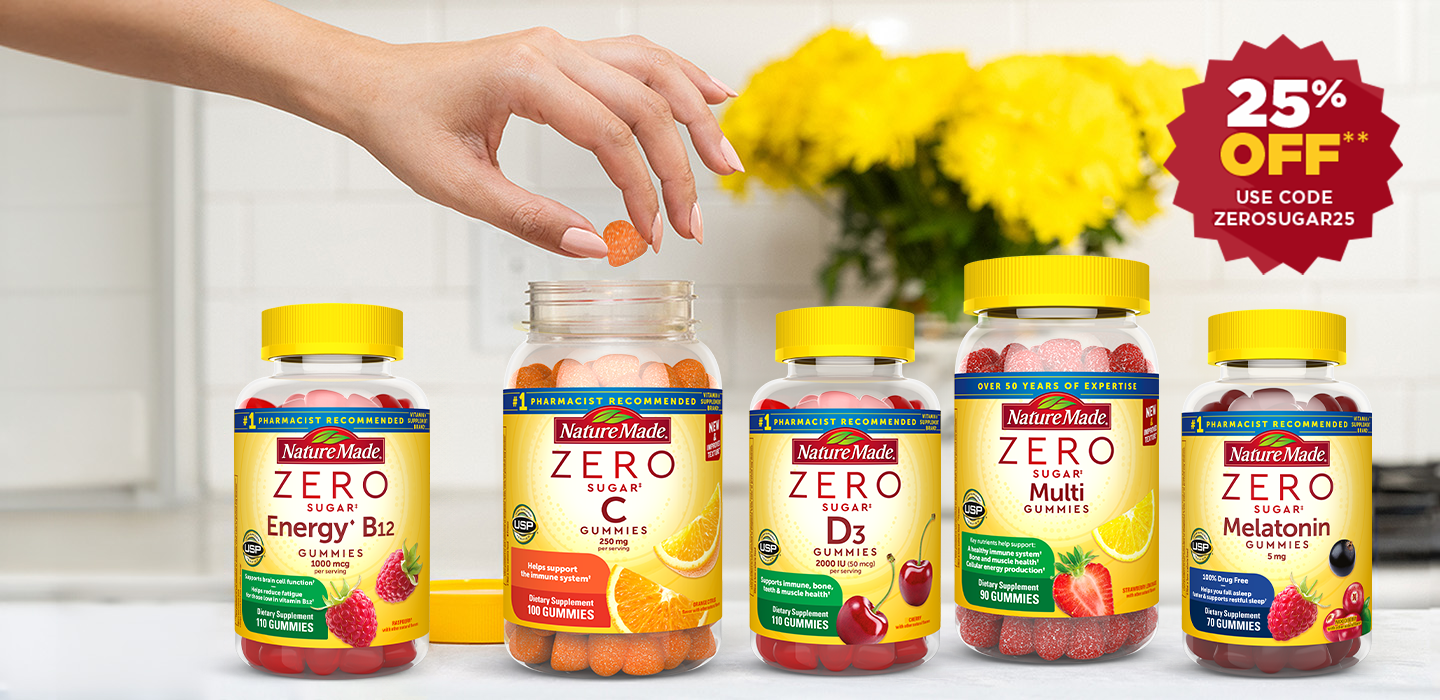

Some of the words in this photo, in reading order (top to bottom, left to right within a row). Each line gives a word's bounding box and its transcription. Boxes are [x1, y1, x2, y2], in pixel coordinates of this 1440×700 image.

[1005, 382, 1017, 390] 50
[1022, 382, 1059, 390] YEARS
[1064, 382, 1079, 390] OF
[1084, 382, 1137, 390] EXPERTISE
[512, 392, 527, 411] #1
[531, 397, 603, 405] PHARMACIST
[609, 397, 696, 405] RECOMMENDED
[243, 412, 256, 429] #1
[758, 414, 771, 430] #1
[1190, 416, 1204, 433] #1
[998, 436, 1114, 465] ZERO
[550, 450, 675, 479] ZERO
[273, 471, 388, 499] ZERO
[788, 471, 901, 499] ZERO
[1222, 473, 1333, 501] ZERO
[1030, 482, 1084, 502] Multi
[601, 496, 627, 523] C
[964, 504, 983, 514] USP
[1024, 504, 1089, 513] GUMMIES
[363, 516, 395, 537] B12
[513, 521, 534, 530] USP
[580, 526, 647, 535] GUMMIES
[827, 516, 865, 545] D3
[1223, 517, 1330, 537] Melatonin
[244, 544, 262, 553] USP
[760, 543, 777, 553] USP
[970, 546, 989, 555] healthy
[1192, 542, 1209, 551] USP
[1246, 540, 1309, 549] GUMMIES
[298, 549, 363, 558] GUMMIES
[813, 548, 877, 557] GUMMIES
[1273, 553, 1286, 561] mg
[333, 561, 350, 569] mcg
[527, 562, 546, 571] Helps
[547, 565, 578, 573] support
[847, 560, 858, 568] (50
[859, 560, 875, 568] mcg)
[966, 561, 983, 569] Cellular
[984, 564, 1003, 573] energy
[245, 574, 262, 582] Supports
[531, 571, 558, 581] immune
[1218, 576, 1233, 584] Drug
[761, 576, 782, 586] Supports
[783, 580, 811, 589] immune,
[812, 582, 834, 590] bone,
[978, 579, 998, 589] Dietary
[999, 581, 1039, 591] Supplement
[282, 590, 302, 598] fatigue
[781, 588, 804, 597] muscle
[980, 590, 989, 600] 90
[991, 591, 1039, 604] GUMMIES
[1201, 586, 1212, 594] Helps
[1233, 590, 1252, 598] asleep
[529, 594, 550, 605] Dietary
[551, 596, 594, 607] Supplement
[257, 608, 275, 618] Dietary
[276, 610, 314, 620] Supplement
[527, 605, 540, 615] 100
[542, 606, 594, 620] GUMMIES
[773, 606, 791, 616] Dietary
[792, 608, 828, 618] Supplement
[1204, 607, 1223, 617] Dietary
[1224, 610, 1260, 619] Supplement
[256, 618, 267, 628] 110
[269, 620, 314, 632] GUMMIES
[772, 616, 783, 625] 110
[784, 617, 829, 630] GUMMIES
[1207, 617, 1214, 627] 70
[1216, 618, 1261, 631] GUMMIES
